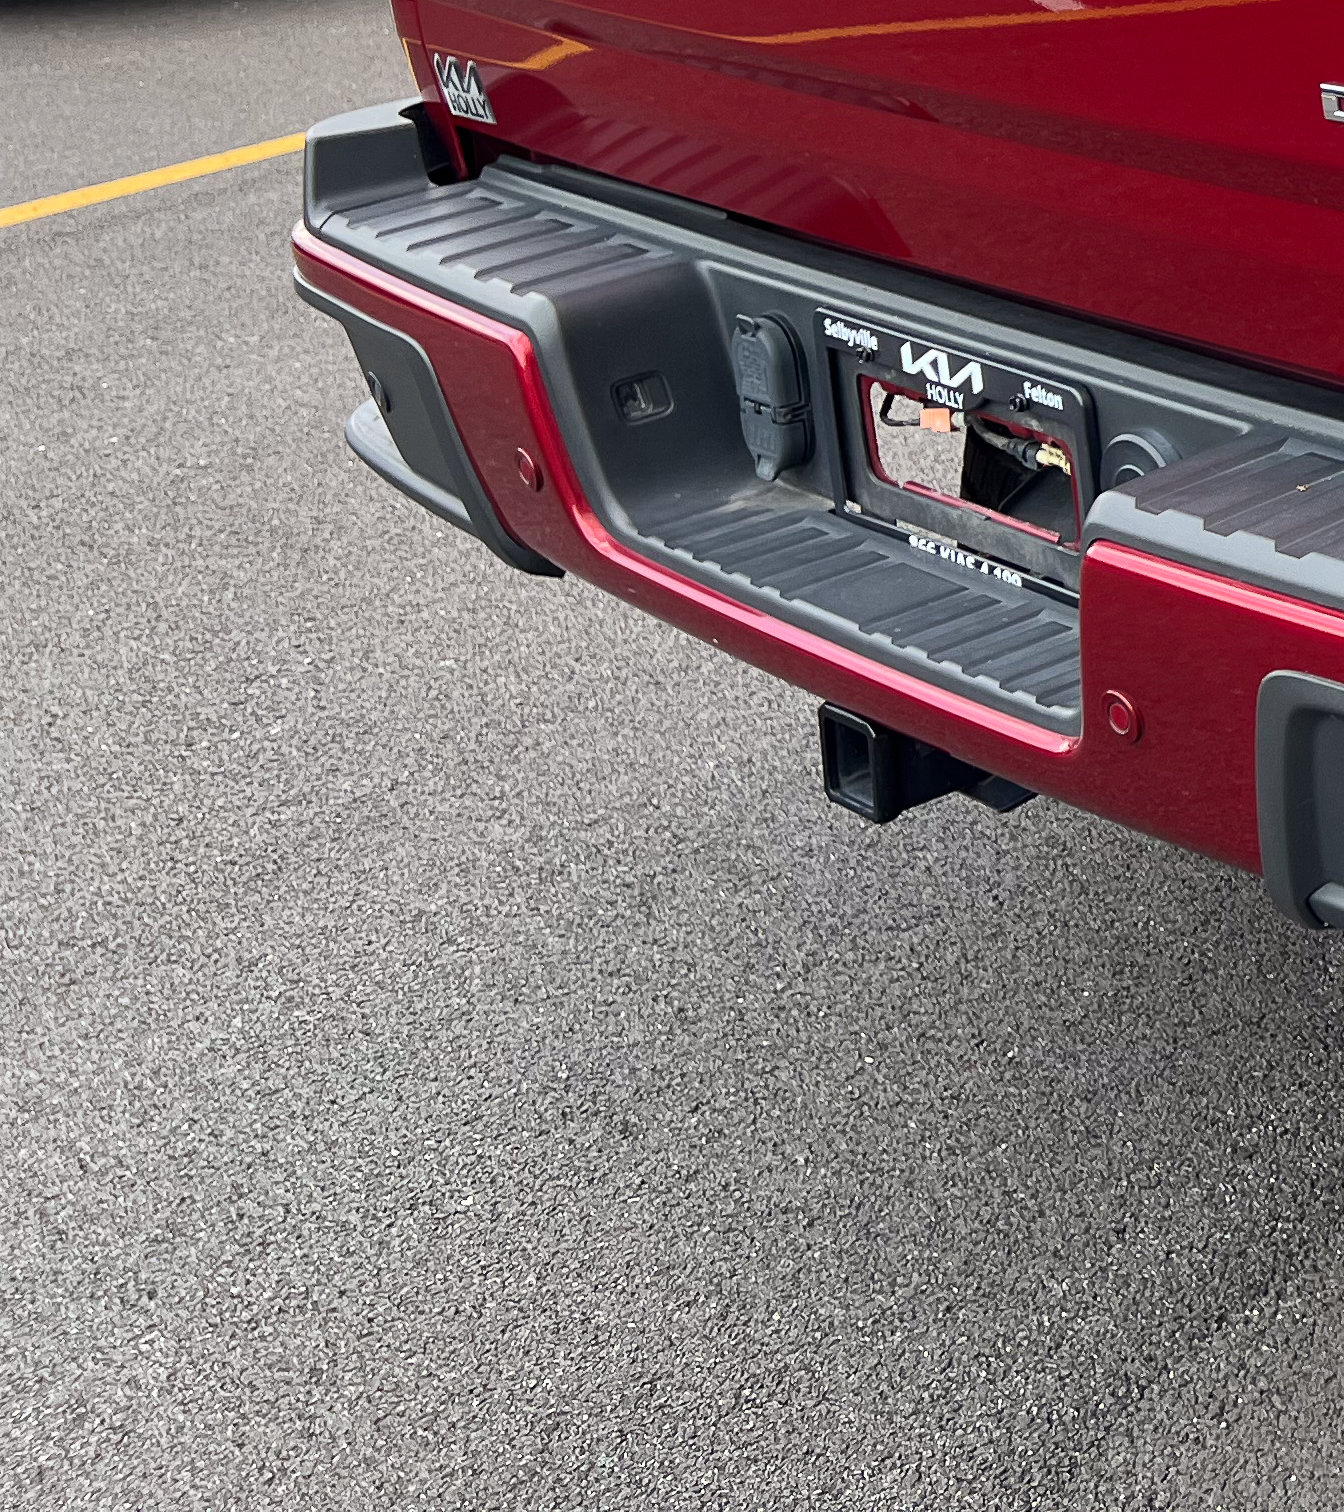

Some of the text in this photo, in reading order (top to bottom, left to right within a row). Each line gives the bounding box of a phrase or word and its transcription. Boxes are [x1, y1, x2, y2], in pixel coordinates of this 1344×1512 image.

[433, 52, 485, 97] KIA
[449, 91, 491, 121] HOLLY
[823, 317, 879, 351] Selbyville
[900, 340, 984, 395] KIA
[925, 382, 964, 410] HOLLY
[1022, 380, 1064, 411] Felton
